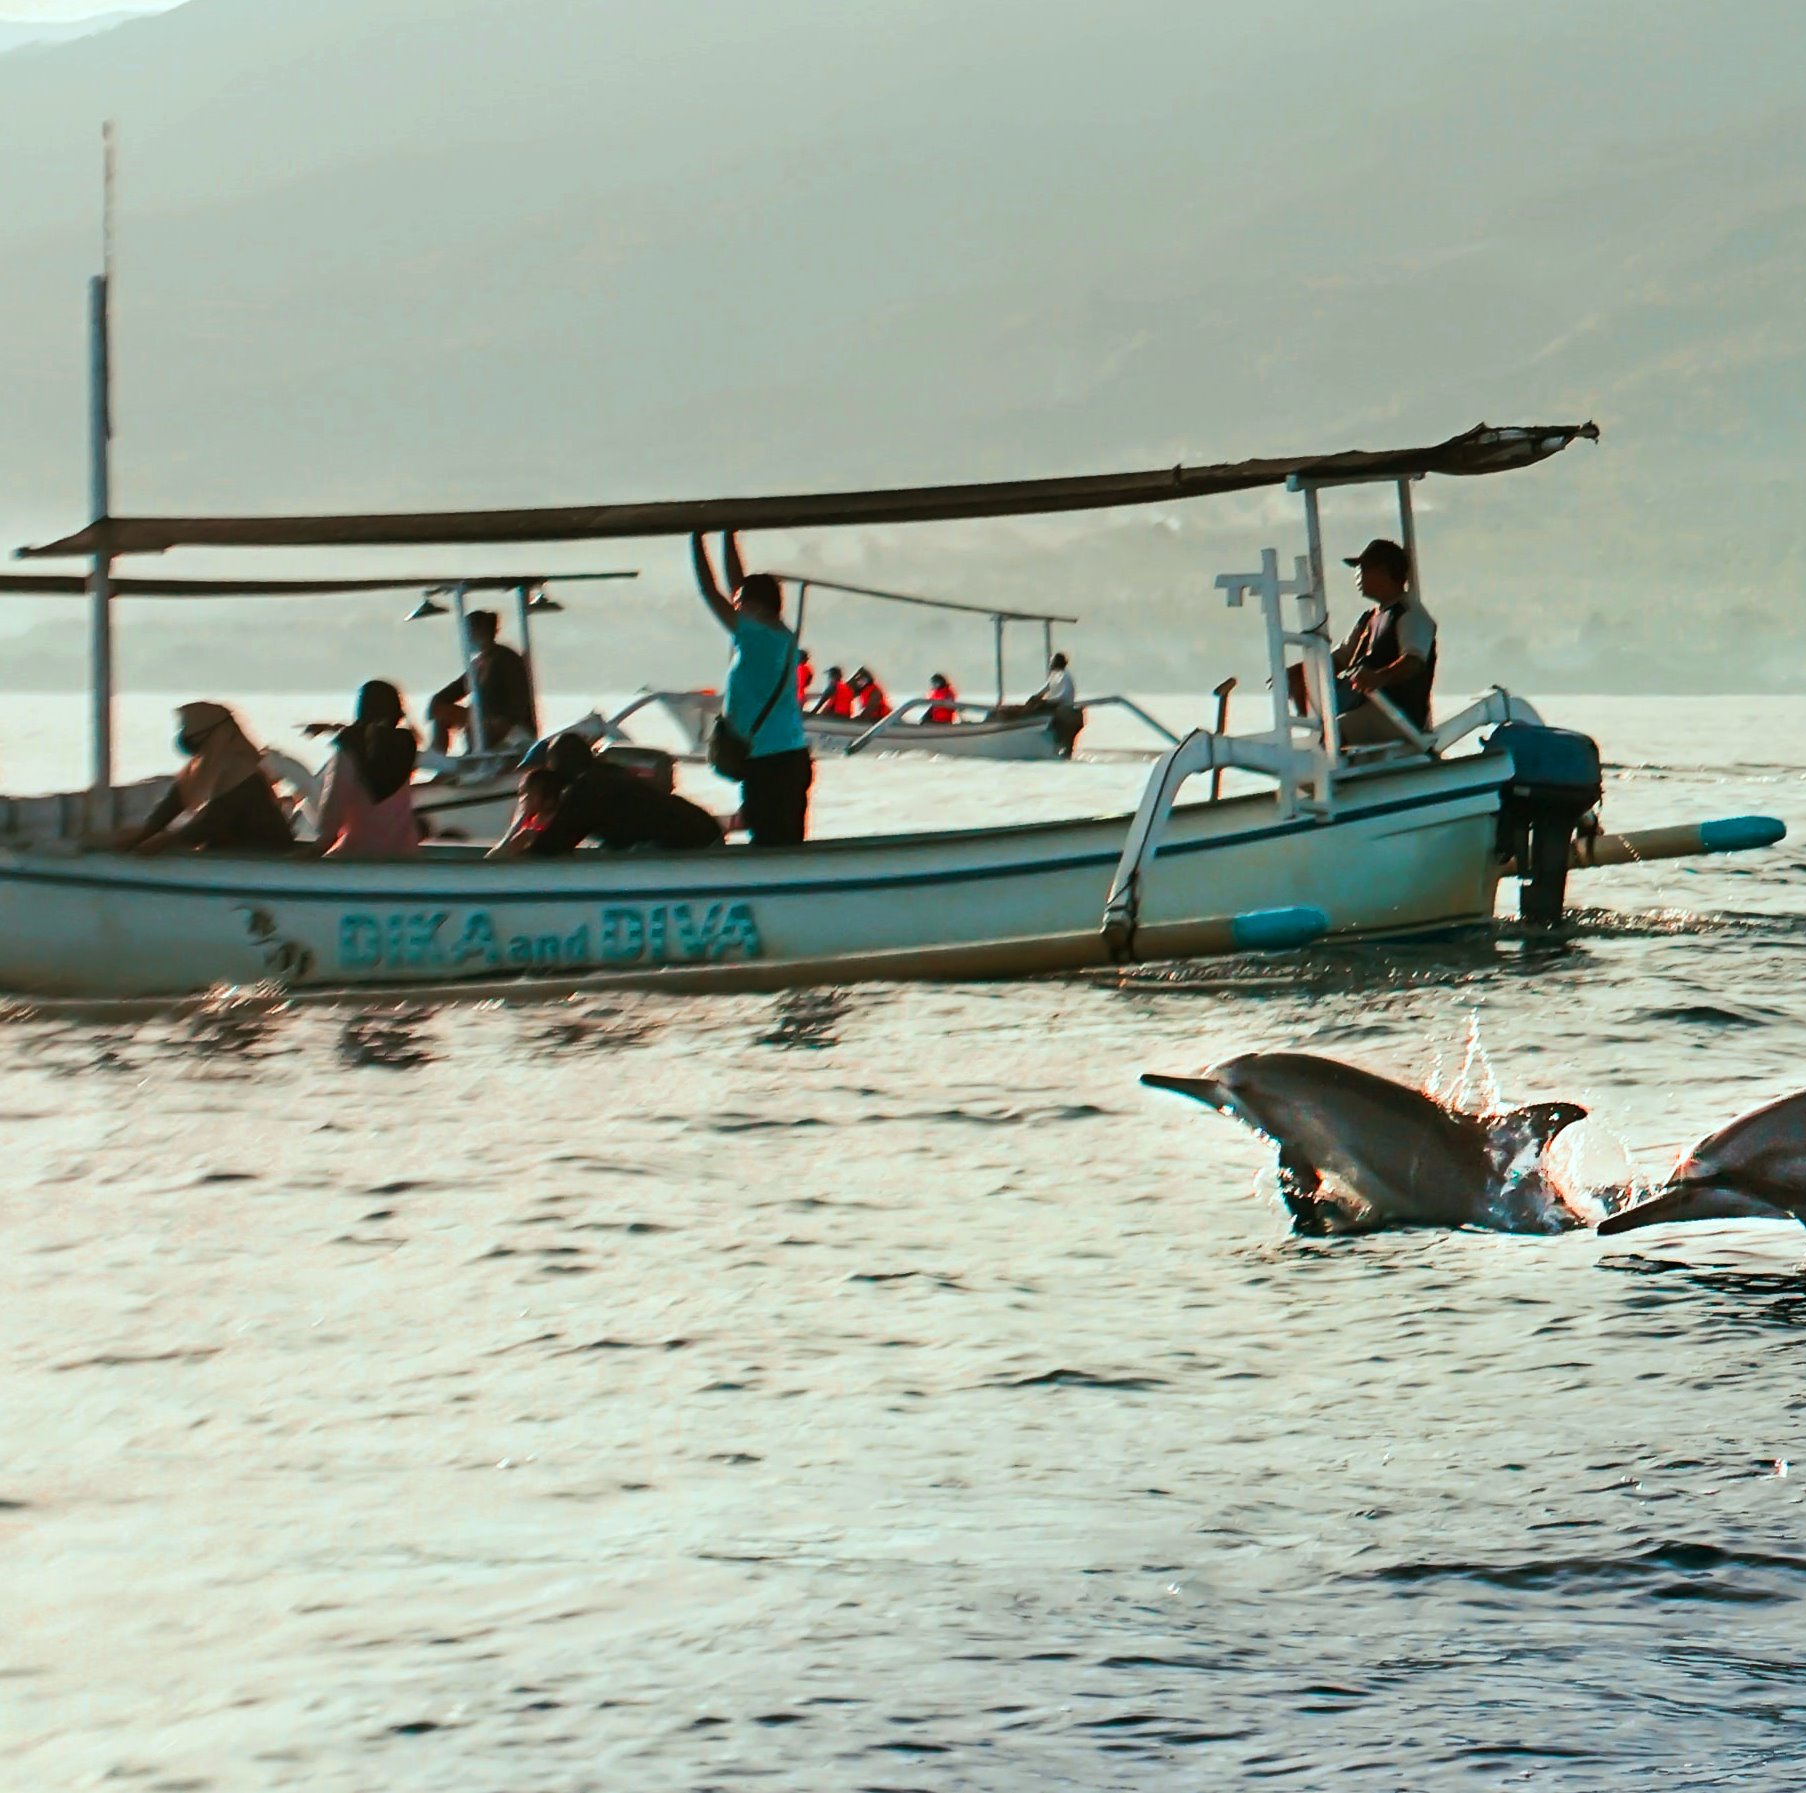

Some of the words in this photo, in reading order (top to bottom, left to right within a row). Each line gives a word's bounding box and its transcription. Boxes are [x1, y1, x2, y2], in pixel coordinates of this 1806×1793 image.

[339, 910, 499, 968] DIKA
[508, 922, 589, 965] and
[601, 902, 762, 962] DIVA
